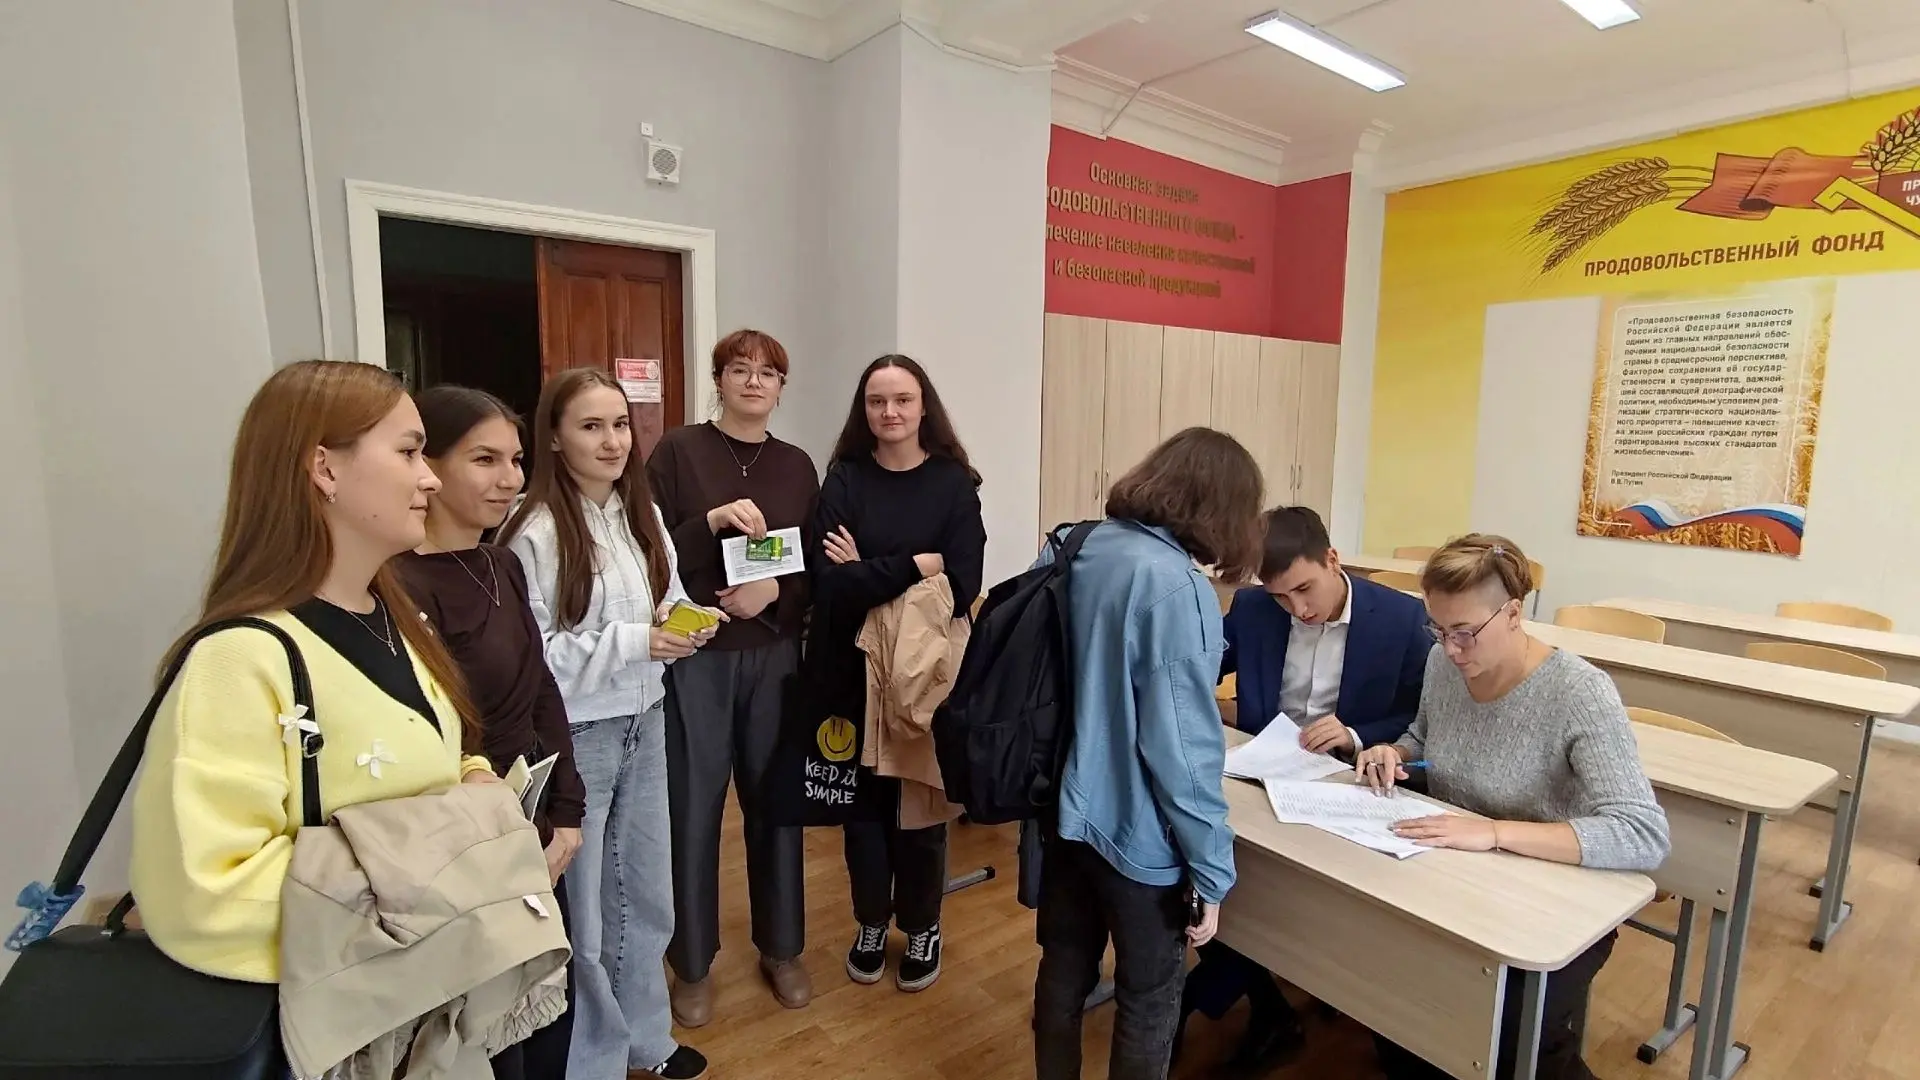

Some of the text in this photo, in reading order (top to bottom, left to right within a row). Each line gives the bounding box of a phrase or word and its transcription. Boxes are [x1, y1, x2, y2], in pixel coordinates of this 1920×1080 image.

[1089, 161, 1152, 195] Основная
[1047, 186, 1191, 233] ОДОВОЛЬСТВЕННОГО
[1584, 230, 1885, 276] ПРОДОВОЛЬСТВЕННЫЙ ФОНД
[1053, 258, 1063, 275] и
[1067, 257, 1145, 287] безопасной
[1726, 308, 1794, 319] безопасность
[1626, 319, 1792, 335] Российской Федерации является
[1666, 336, 1700, 344] главных
[1703, 331, 1761, 341] направлений
[1661, 344, 1721, 354] национальной
[1726, 342, 1790, 351] безопасности
[1623, 358, 1652, 366] страны
[1622, 368, 1664, 376] фактором
[1668, 366, 1722, 375] сохранения
[1742, 364, 1787, 373] государ-
[1621, 378, 1666, 386] ственности
[1639, 387, 1700, 395] составляющей
[1702, 385, 1784, 395] демографической
[1658, 397, 1716, 405] необходимым
[1654, 408, 1724, 416] стратегического
[1728, 408, 1781, 416] националь-
[1636, 419, 1682, 427] приоритета
[1656, 428, 1705, 437] российских
[1709, 430, 1747, 438] граждан
[1614, 438, 1679, 446] гарантирования
[1725, 440, 1777, 448] стандартов
[804, 756, 858, 787] KEEP it
